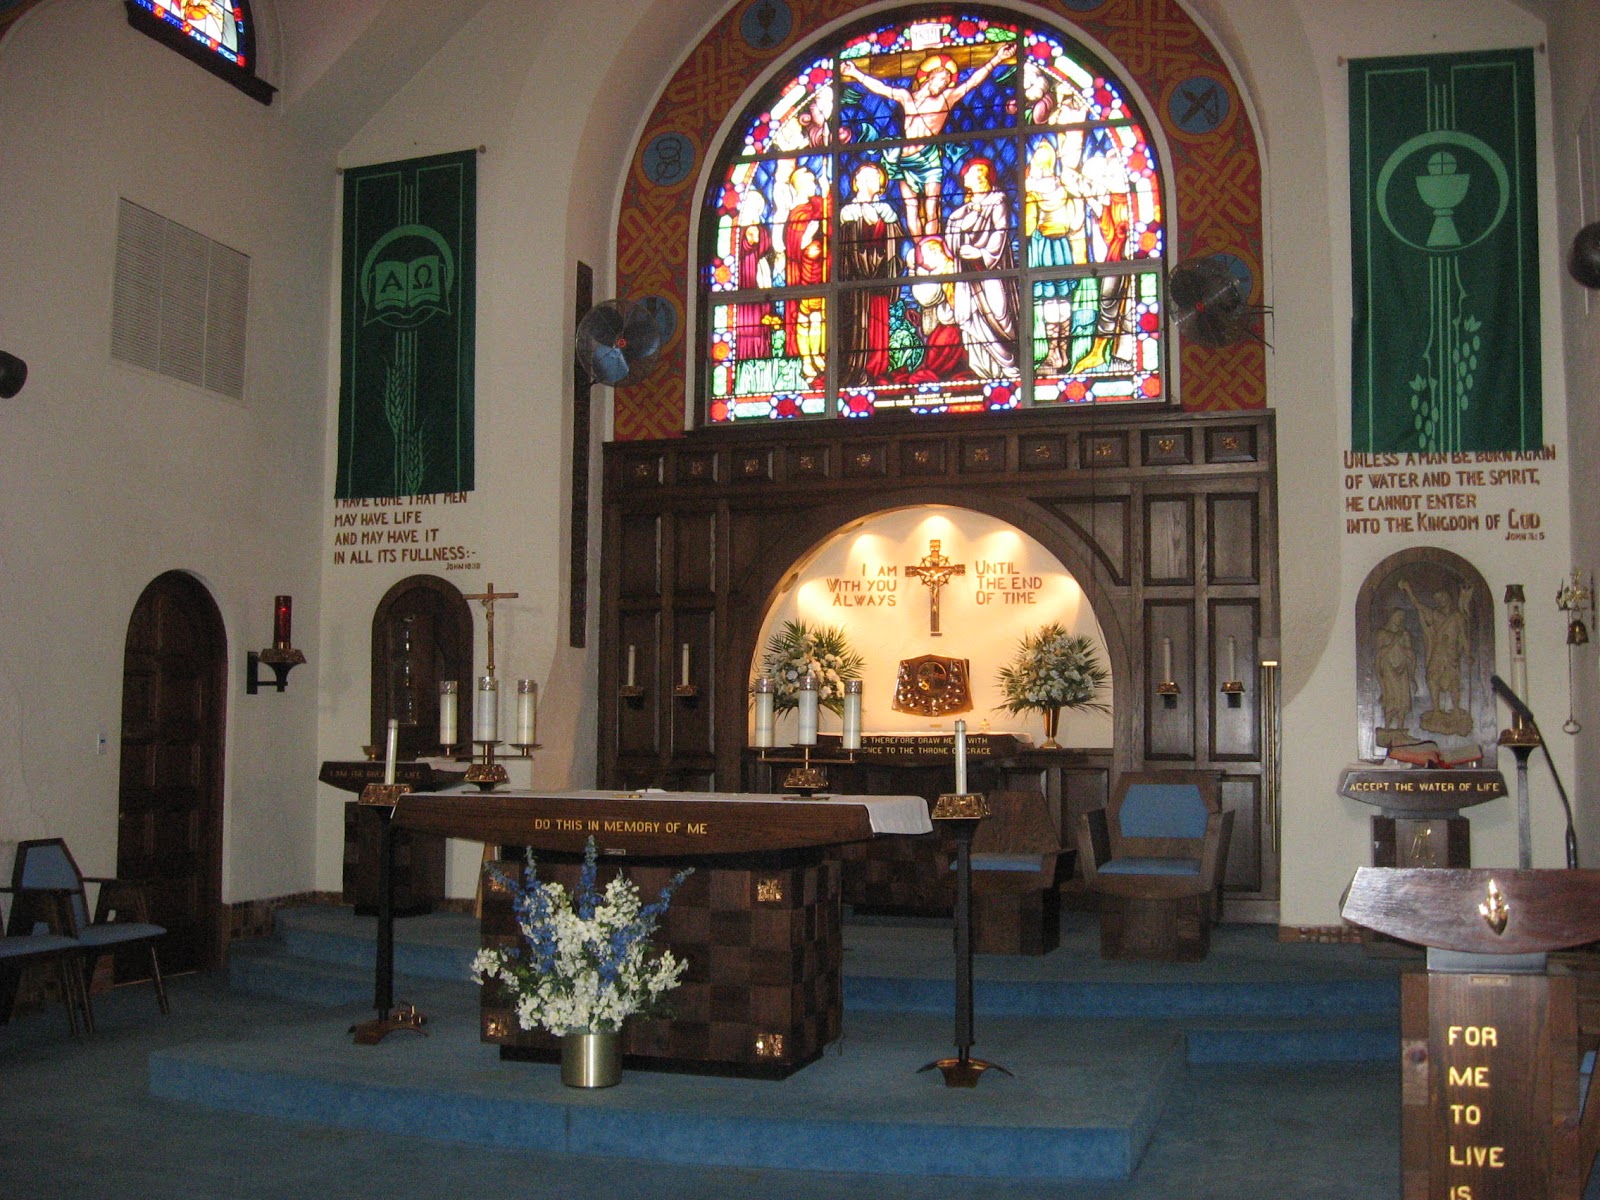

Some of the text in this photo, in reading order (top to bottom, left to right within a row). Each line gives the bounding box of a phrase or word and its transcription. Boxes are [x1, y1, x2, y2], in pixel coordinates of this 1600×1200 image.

[1344, 445, 1556, 468] UNLESS A MAN BE BORN AGAIN
[1345, 474, 1363, 490] OF
[1369, 472, 1419, 489] WATER
[1422, 472, 1451, 488] AND
[1455, 470, 1486, 486] THE
[343, 497, 369, 508] HAVE
[374, 497, 403, 507] COME
[409, 494, 437, 505] THAT
[444, 492, 467, 504] MEN
[1345, 493, 1477, 512] HE CANNOT ENTER
[334, 511, 422, 527] MAY HAVE LIFE
[1346, 508, 1541, 534] INTO THE KINGDOM OF GOD
[334, 528, 439, 546] AND MAY HAVE IT
[1505, 531, 1527, 541] JOHN
[334, 551, 345, 565] IN
[350, 550, 373, 564] ALL
[378, 549, 397, 563] ITS
[446, 562, 464, 571] JOHN
[862, 563, 897, 577] I AM
[975, 560, 1020, 575] UNTIL
[826, 578, 897, 593] WITH YOU
[978, 575, 1043, 590] THE END
[832, 592, 897, 607] ALWAYS
[976, 591, 1037, 605] OF TIME
[871, 736, 915, 744] THEREFORE
[918, 735, 940, 744] DRAW
[886, 746, 896, 754] TO
[899, 746, 915, 754] THE
[918, 746, 949, 754] THRONE
[1350, 782, 1500, 792] ACCEPT THE WATER OF LIFE
[535, 818, 708, 835] DO THIS IN MEMORY OF ME
[1448, 1026, 1498, 1047] FOR
[1449, 1066, 1490, 1087] ME
[1450, 1105, 1481, 1125] TO
[1450, 1145, 1505, 1168] LIVE
[1450, 1186, 1472, 1200] IS
